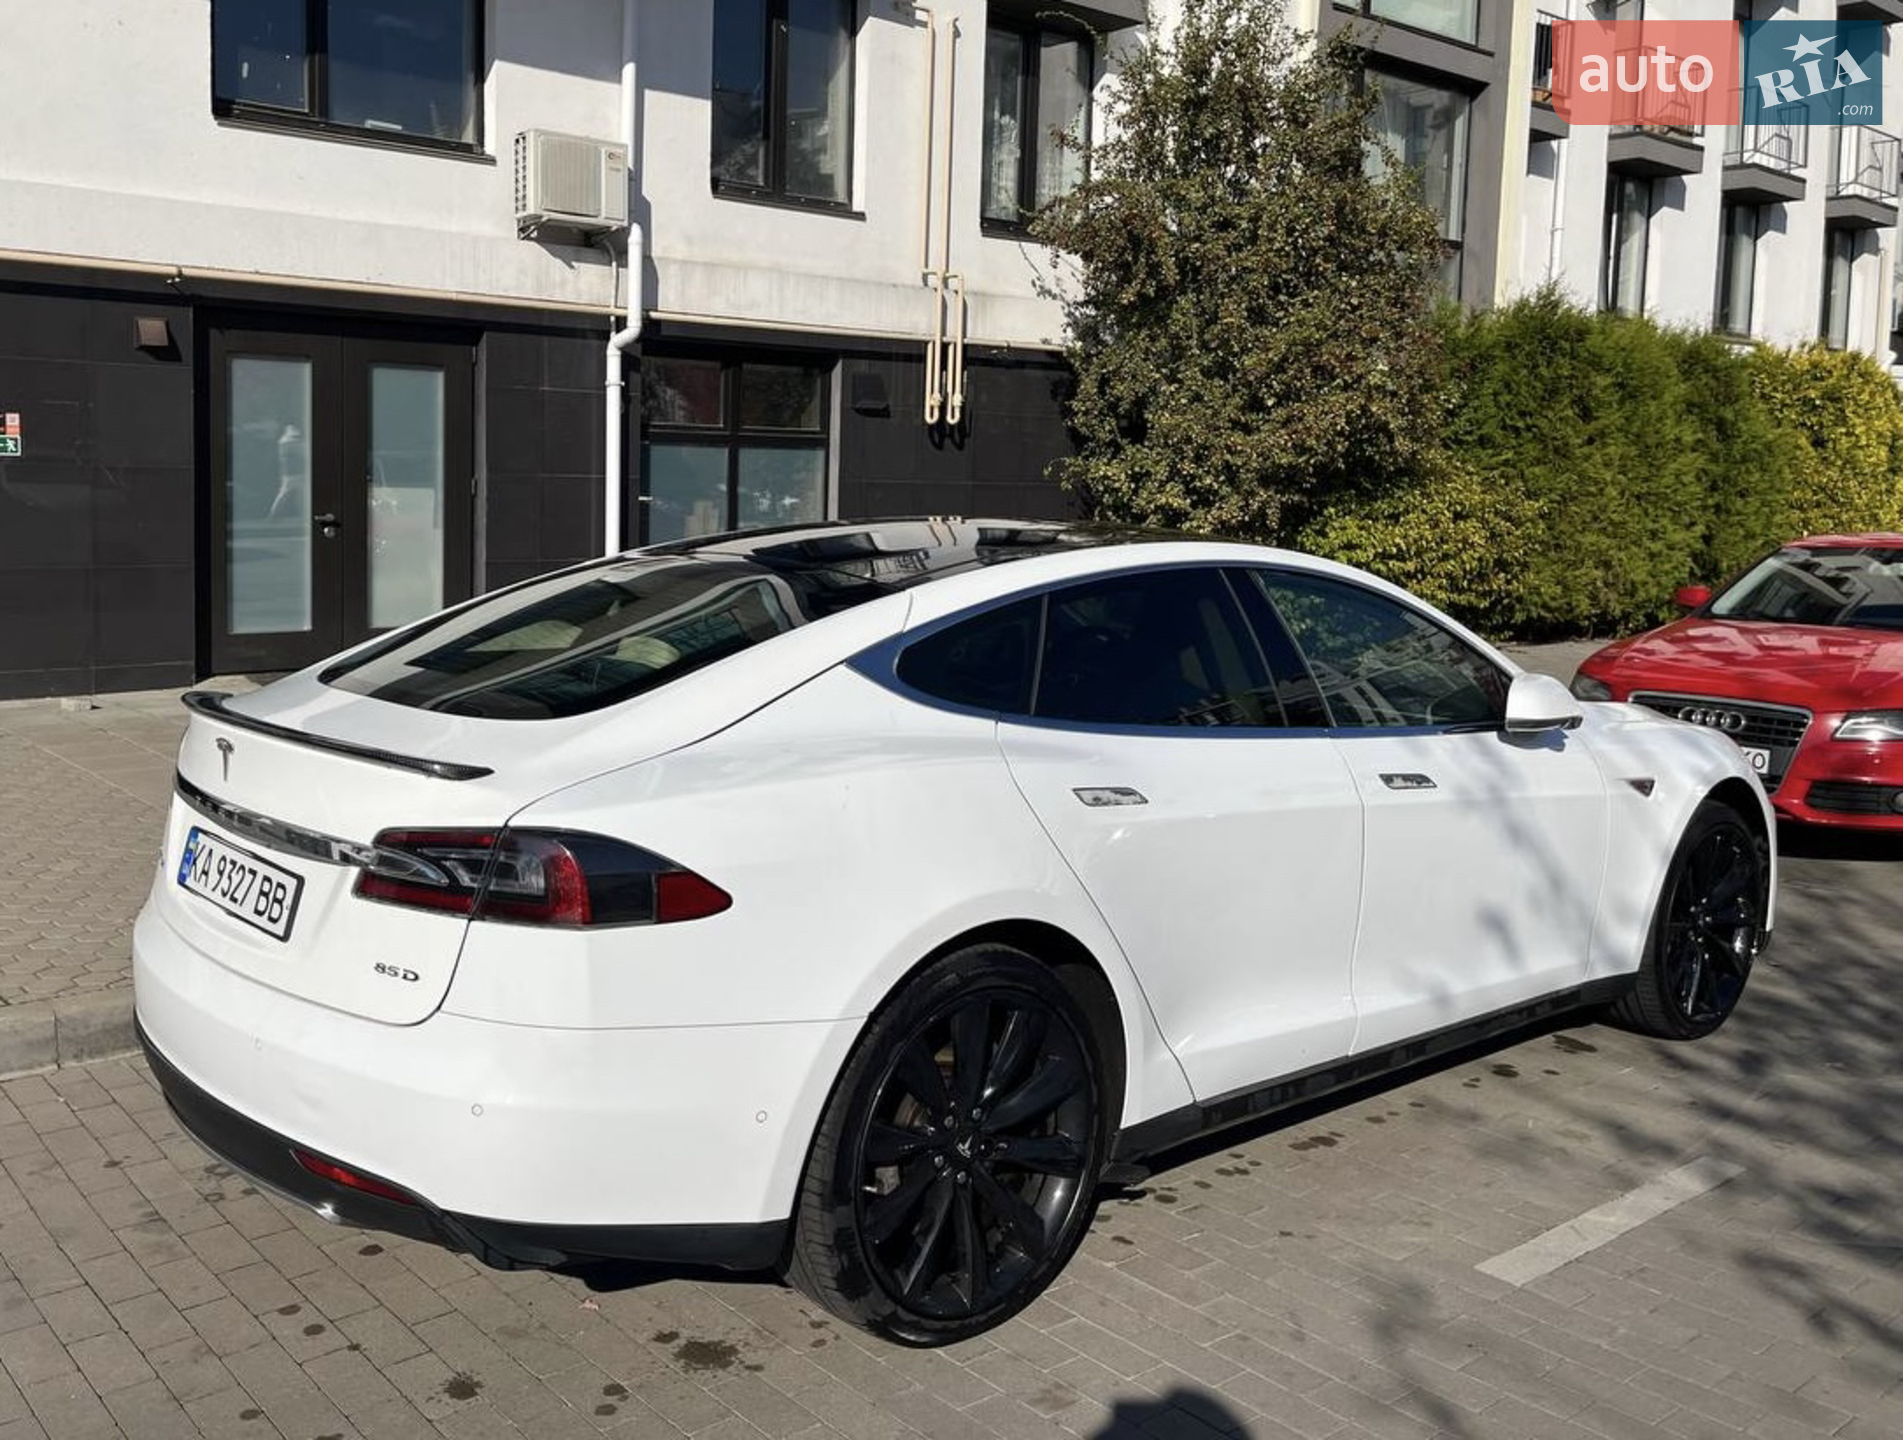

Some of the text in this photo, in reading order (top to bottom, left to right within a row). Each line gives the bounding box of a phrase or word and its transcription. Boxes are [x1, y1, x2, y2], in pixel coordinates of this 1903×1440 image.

[189, 841, 287, 925] KA 9327 BB
[373, 962, 420, 982] 85D
